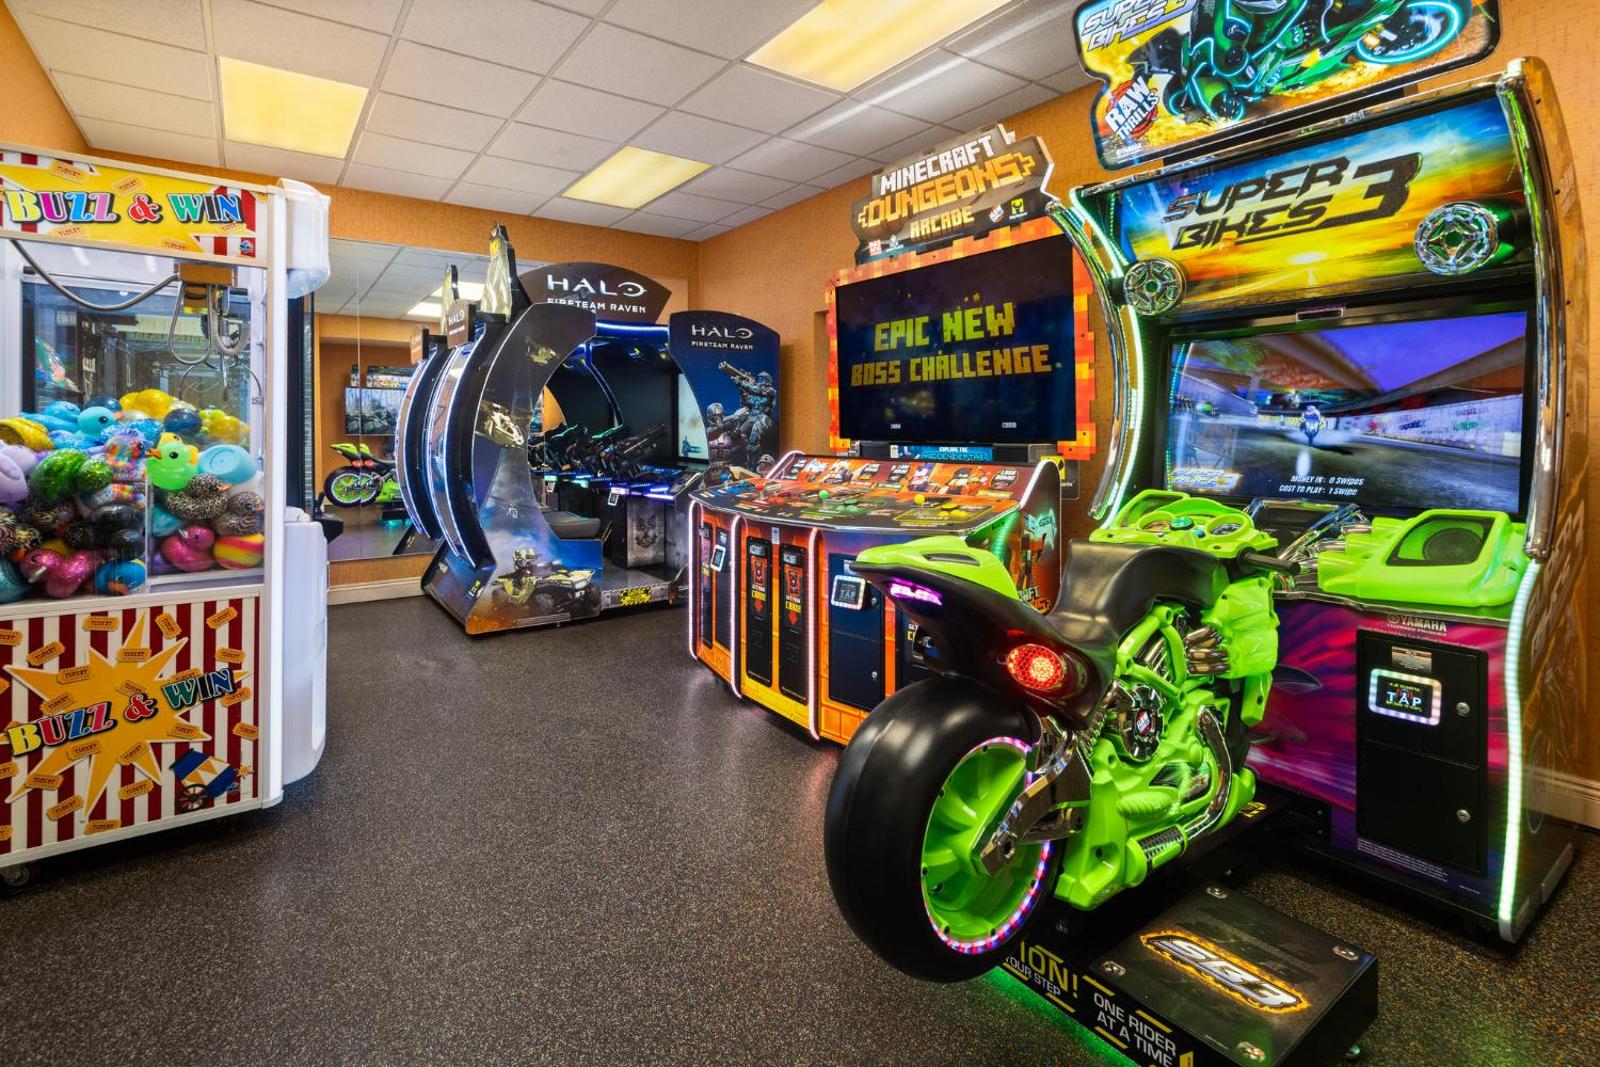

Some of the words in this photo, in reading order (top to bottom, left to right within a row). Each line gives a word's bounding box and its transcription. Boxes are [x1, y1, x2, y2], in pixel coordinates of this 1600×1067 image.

[1105, 76, 1151, 132] RAW
[1117, 92, 1159, 145] THRILLS
[881, 135, 995, 196] MINECRAFT
[1348, 152, 1423, 217] 3
[4, 190, 121, 223] BUZZ
[128, 193, 163, 224] &
[167, 193, 245, 224] WIN
[866, 153, 1024, 228] DUNGEONS
[1162, 155, 1351, 224] SUPER
[911, 205, 975, 238] ARCADE
[1171, 194, 1334, 250] BIKES
[547, 274, 647, 297] HALO
[610, 304, 646, 313] RAVEN
[692, 324, 754, 339] HALO
[692, 341, 728, 349] FIRETEAM
[874, 316, 930, 352] EPIC
[942, 302, 1016, 343] NEW
[851, 360, 901, 386] BOSS
[910, 344, 1052, 382] CHALLENGE
[1306, 486, 1326, 494] PLAY:
[1401, 614, 1447, 632] YAMAHA
[8, 701, 118, 758] BUZZ
[124, 693, 158, 723] &
[161, 667, 236, 711] WIN
[1387, 691, 1422, 706] TAP
[1034, 972, 1061, 995] STEP
[1094, 992, 1125, 1022] ONE
[1128, 1014, 1177, 1057] RIDER
[1097, 1010, 1116, 1030] AT
[1119, 1025, 1131, 1042] A
[1133, 1033, 1173, 1067] TIME
